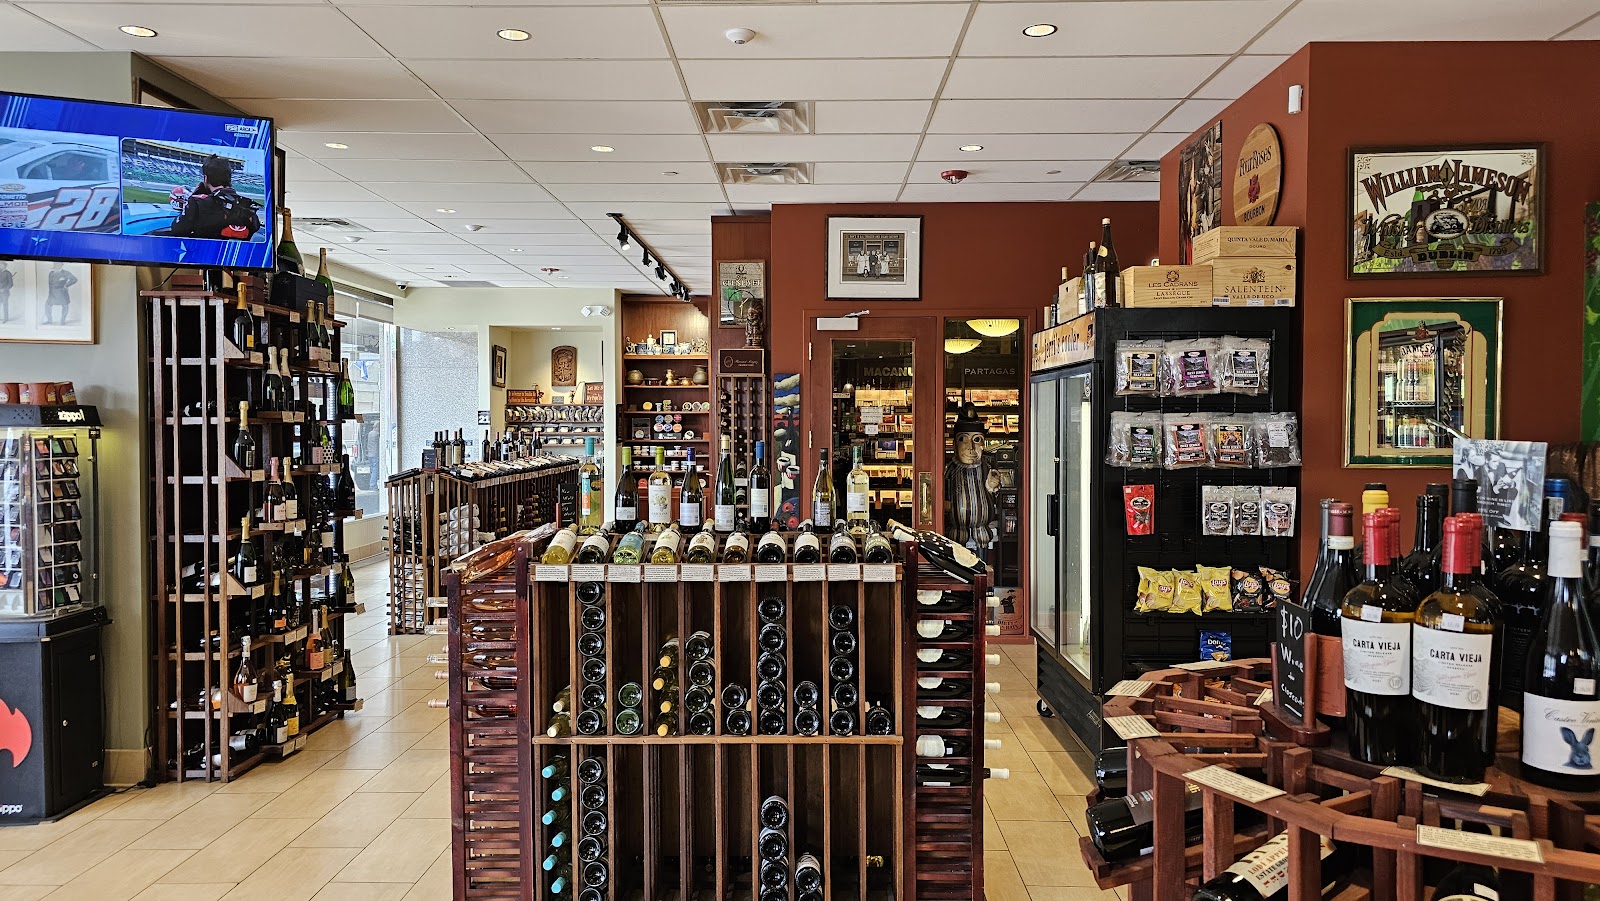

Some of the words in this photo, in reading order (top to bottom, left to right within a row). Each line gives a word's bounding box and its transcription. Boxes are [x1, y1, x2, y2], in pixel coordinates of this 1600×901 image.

[1359, 165, 1441, 214] WILLIAM
[1452, 160, 1532, 205] JAMESON
[40, 187, 119, 229] 28
[1244, 204, 1265, 222] BOURBON
[1417, 250, 1474, 261] DUBLIN
[1224, 285, 1282, 293] SALENTEIN
[1280, 605, 1303, 640] $10
[1352, 638, 1375, 650] CARTA
[1378, 641, 1401, 651] VIEJA
[1429, 648, 1456, 662] CARTA
[1459, 653, 1482, 663] VIEJA
[1247, 861, 1266, 875] LODI
[1255, 865, 1276, 881] ESTATE
